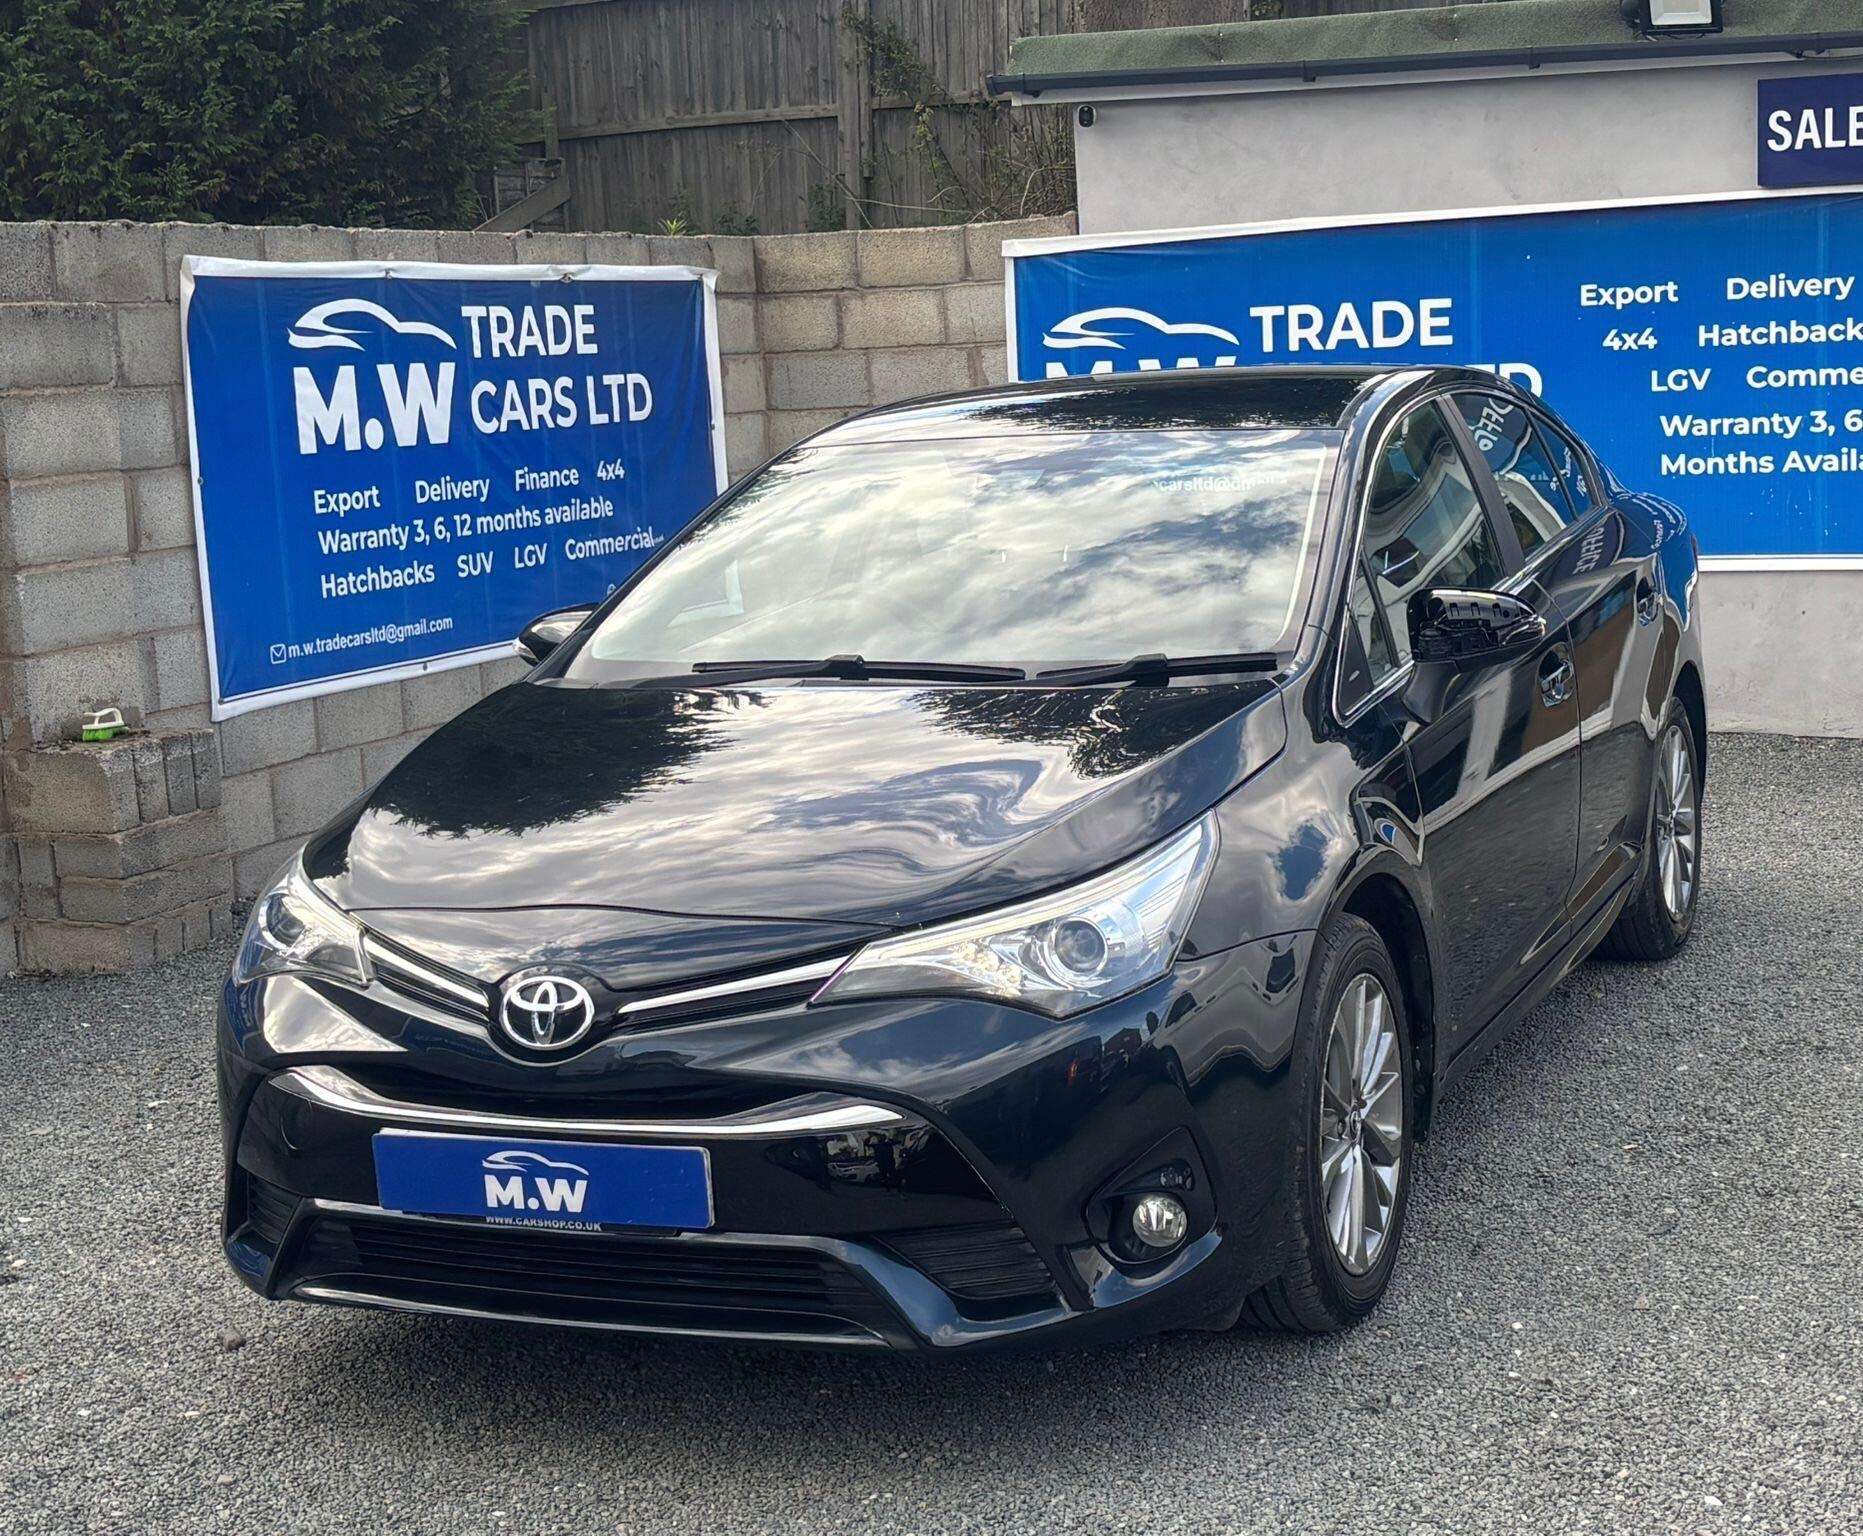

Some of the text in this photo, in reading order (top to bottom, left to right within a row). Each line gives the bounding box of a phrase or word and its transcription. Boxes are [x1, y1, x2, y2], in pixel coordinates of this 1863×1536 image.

[1767, 105, 1863, 152] SALE
[1580, 272, 1855, 310] Export Delivery
[461, 304, 599, 359] TRADE
[1250, 297, 1454, 353] TRADE
[1602, 327, 1658, 351] 4x4
[470, 373, 653, 434] CARS LTD
[1651, 368, 1711, 392] LGV
[293, 361, 456, 455] M.W
[1659, 413, 1803, 439] Warranty
[1809, 410, 1836, 437] 3,
[1661, 450, 1775, 476] Months
[313, 459, 625, 517] Export Delivery Finance 4x4
[318, 496, 614, 555] Warranty 3, 6, 12 months available
[320, 526, 655, 599] Hatchbacks SUV LGV Commercial
[288, 616, 453, 658] m.w.tradecarsltd@gmail.com
[483, 1173, 588, 1213] M.W
